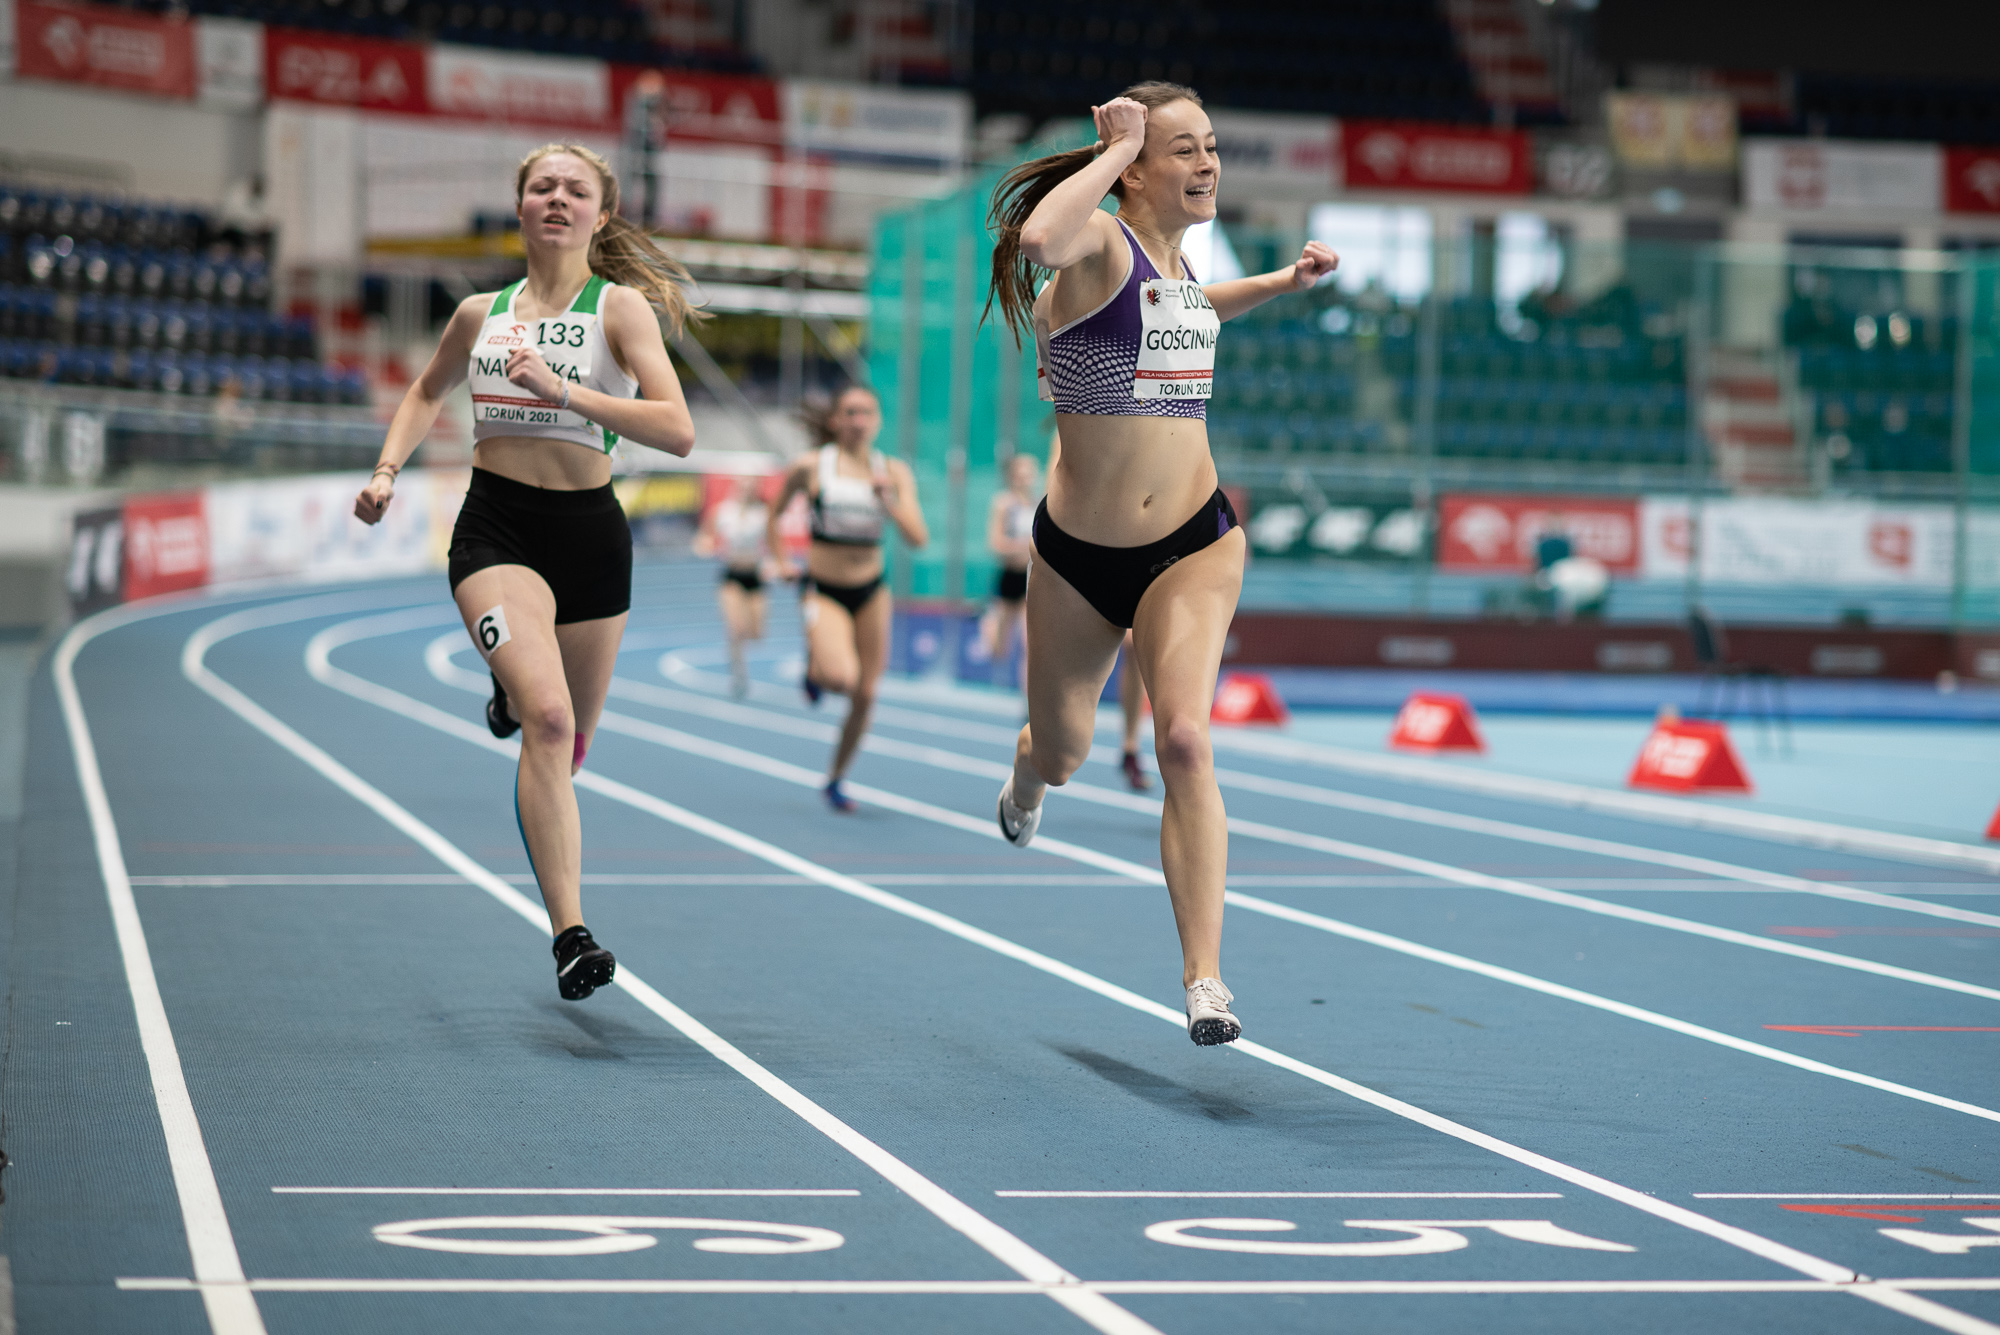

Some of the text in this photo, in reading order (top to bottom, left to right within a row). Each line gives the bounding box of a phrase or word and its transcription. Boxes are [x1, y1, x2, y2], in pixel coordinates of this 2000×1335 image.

[537, 322, 585, 348] 133
[1160, 380, 1193, 396] TORUŃ
[485, 406, 558, 424] TORUŃ 2021
[479, 615, 500, 651] 6
[370, 1215, 846, 1256] 6
[1143, 1217, 1639, 1256] 5
